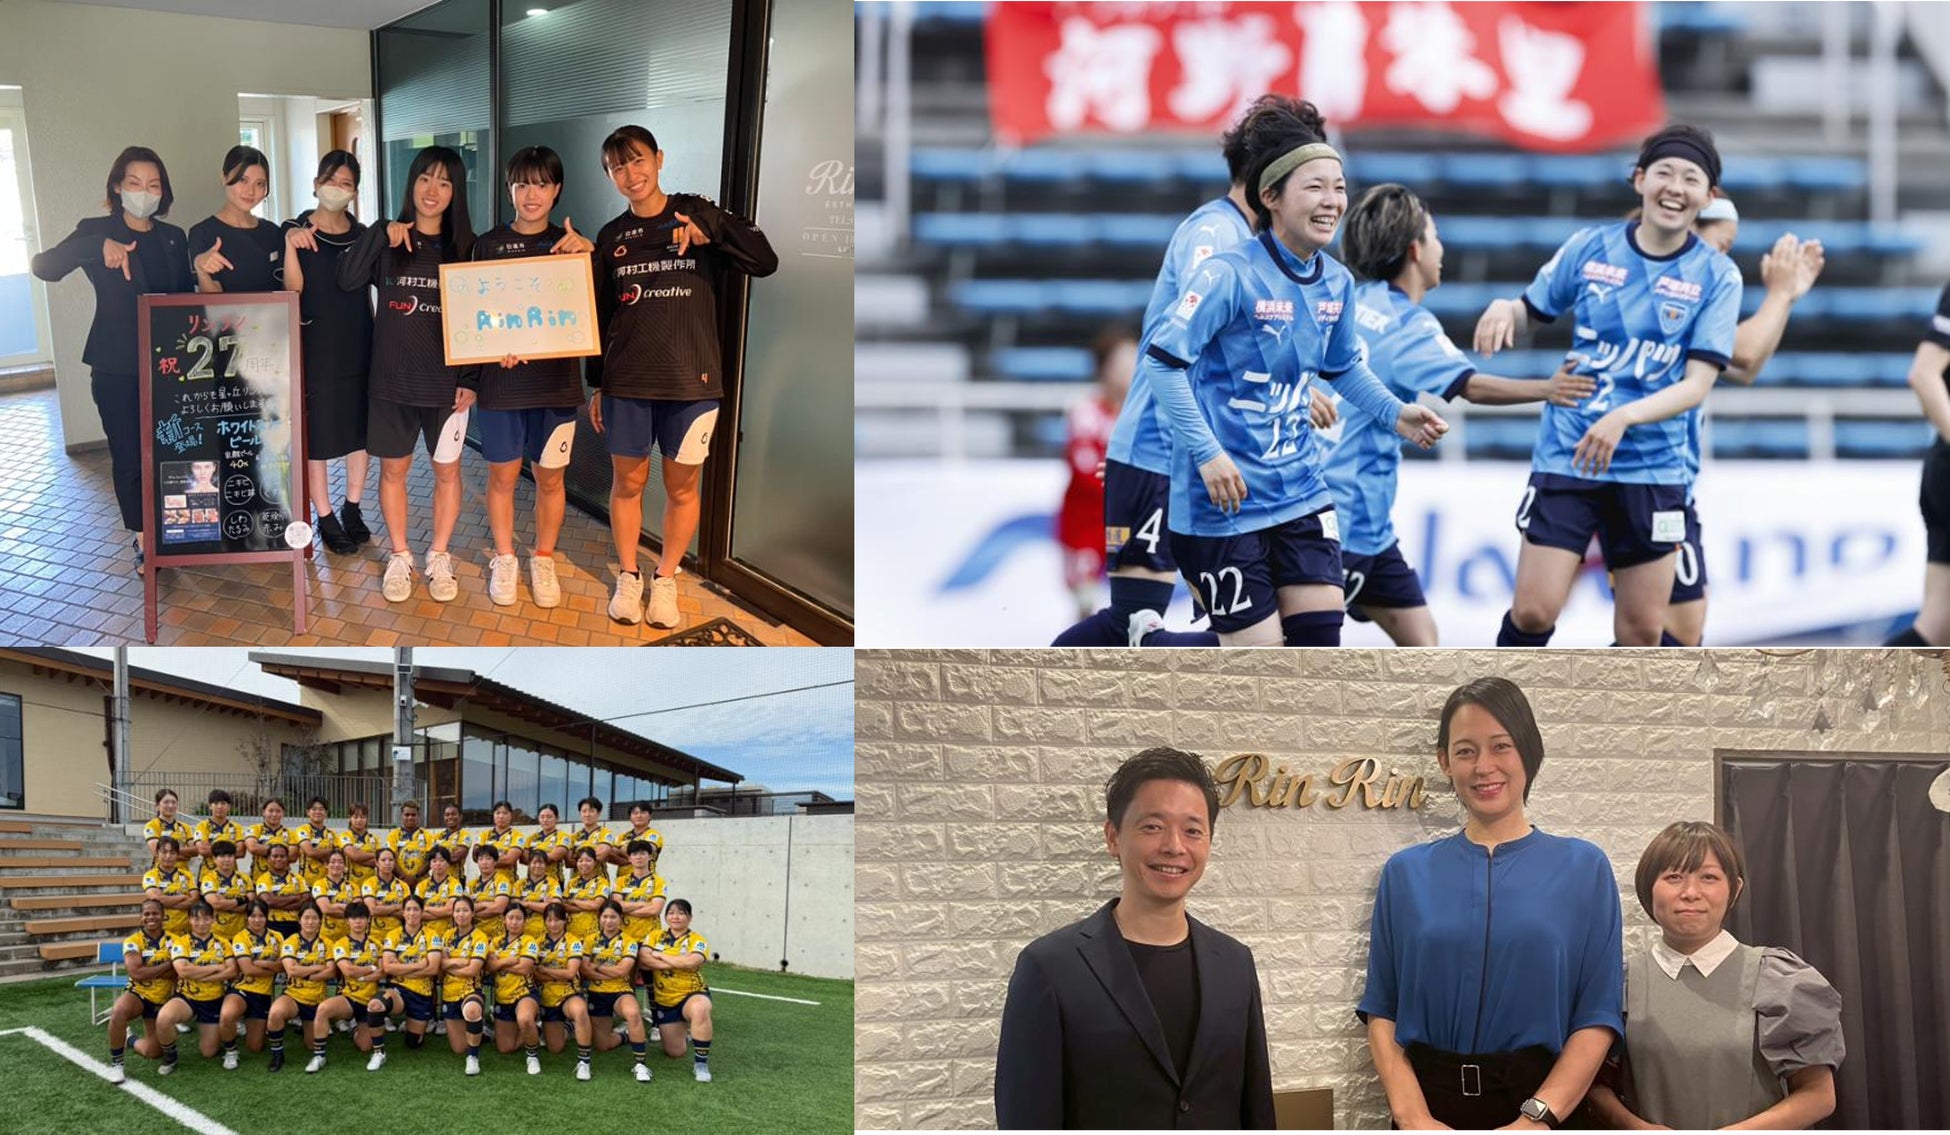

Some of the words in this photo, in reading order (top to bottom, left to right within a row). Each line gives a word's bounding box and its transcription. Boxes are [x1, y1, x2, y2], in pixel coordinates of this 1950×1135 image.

[478, 277, 541, 295] ようこそ
[643, 287, 692, 298] creative
[1135, 507, 1163, 554] 4
[1200, 566, 1253, 617] 22
[1214, 753, 1318, 809] Rin
[1325, 757, 1429, 809] Rin
